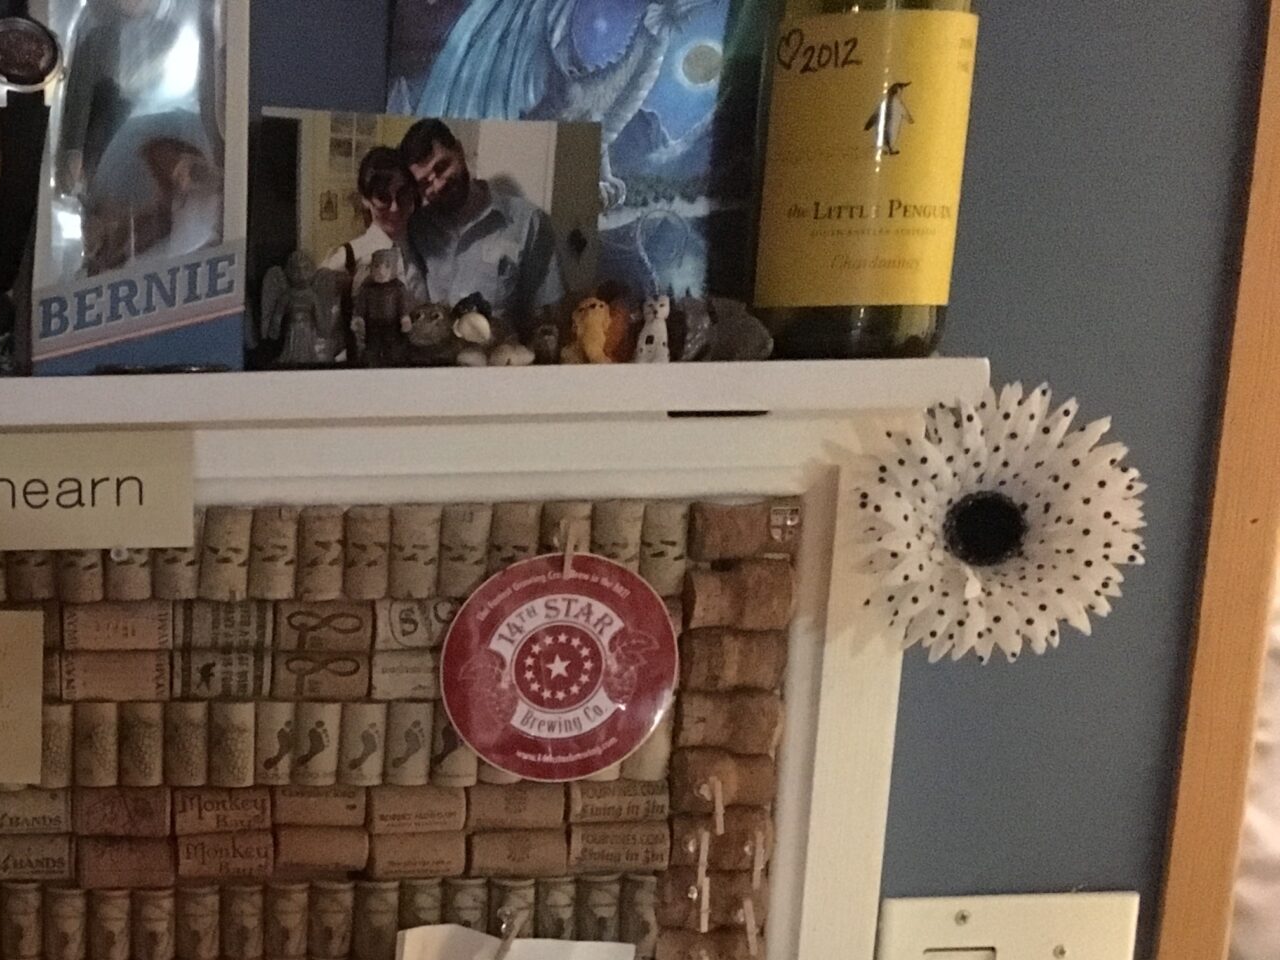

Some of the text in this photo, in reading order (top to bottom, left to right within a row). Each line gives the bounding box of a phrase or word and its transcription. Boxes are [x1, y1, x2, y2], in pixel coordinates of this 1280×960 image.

[799, 36, 863, 75] 2012
[38, 252, 236, 340] BERNIE
[544, 597, 615, 636] STAR
[520, 709, 583, 733] Brewing
[178, 793, 267, 821] Monkey
[11, 857, 67, 871] HANDS
[184, 843, 269, 870] Monkey
